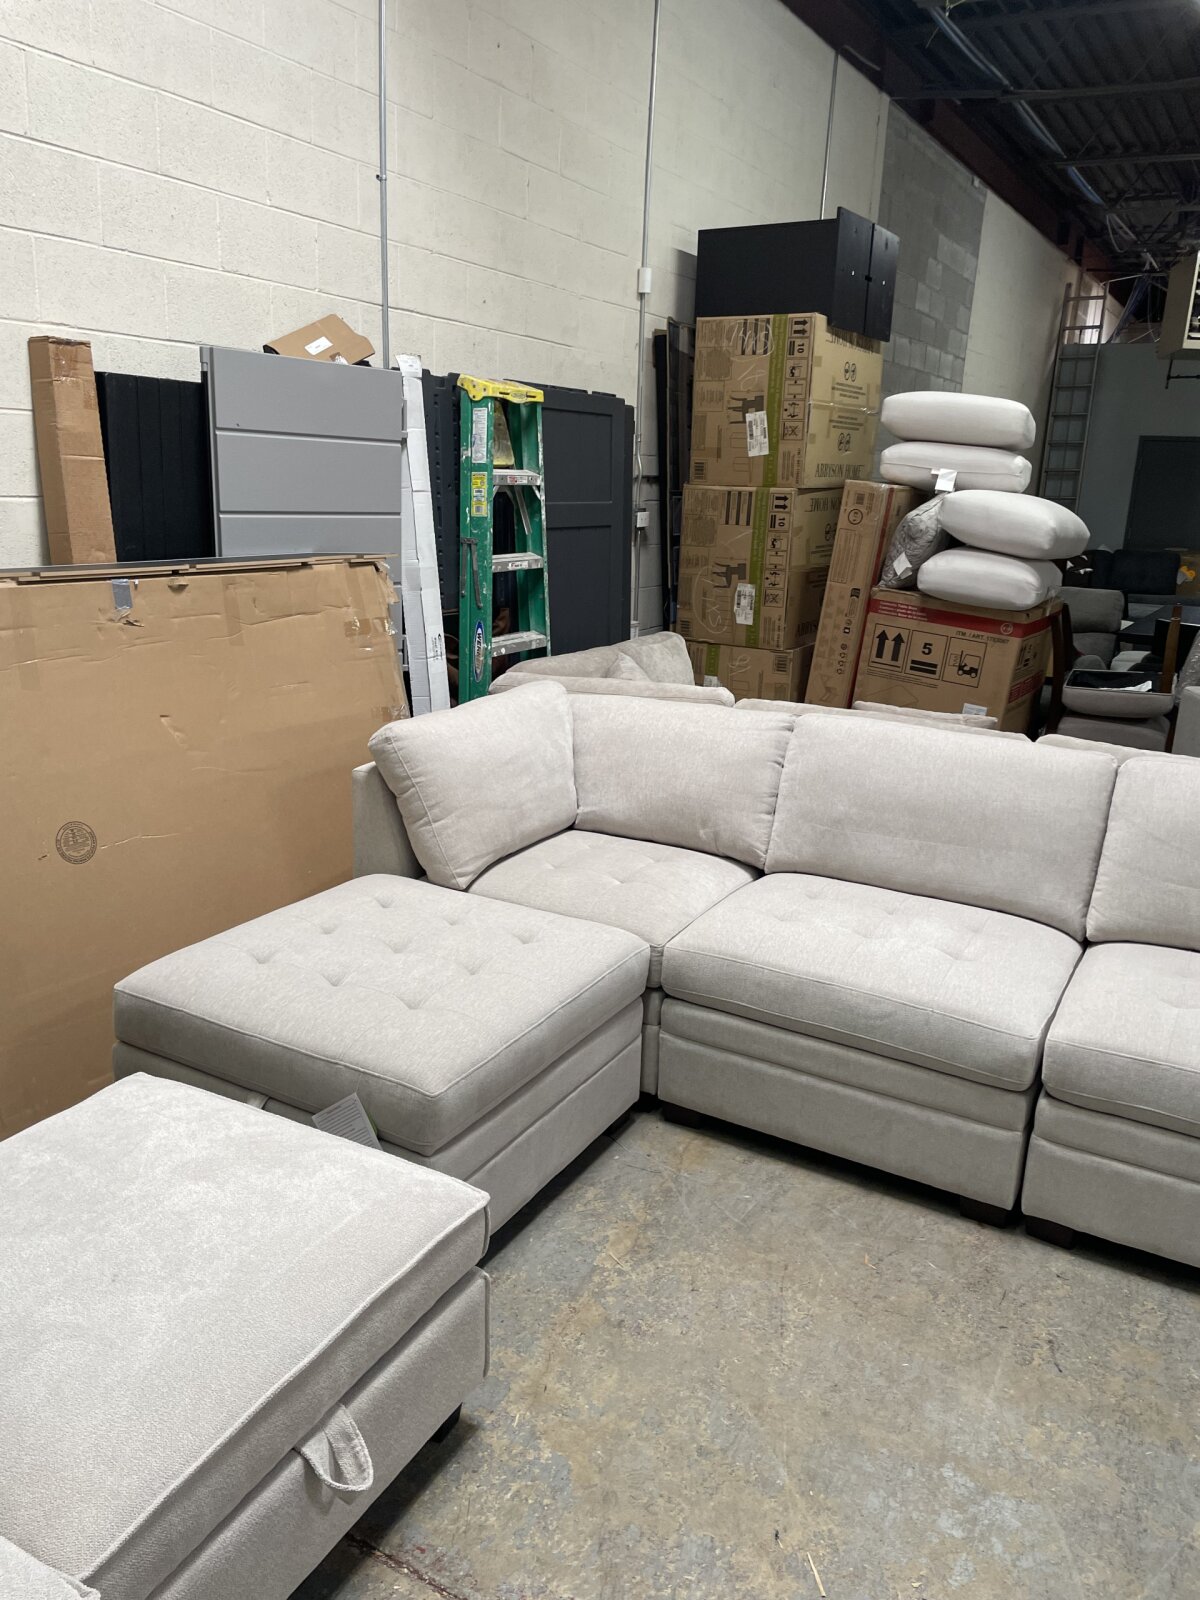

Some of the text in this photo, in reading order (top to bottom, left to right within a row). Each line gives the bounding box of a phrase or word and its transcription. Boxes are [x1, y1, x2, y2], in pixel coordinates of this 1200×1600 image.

[797, 342, 805, 354] 10
[845, 464, 865, 480] HOME
[778, 517, 786, 527] 10
[921, 642, 934, 656] 5
